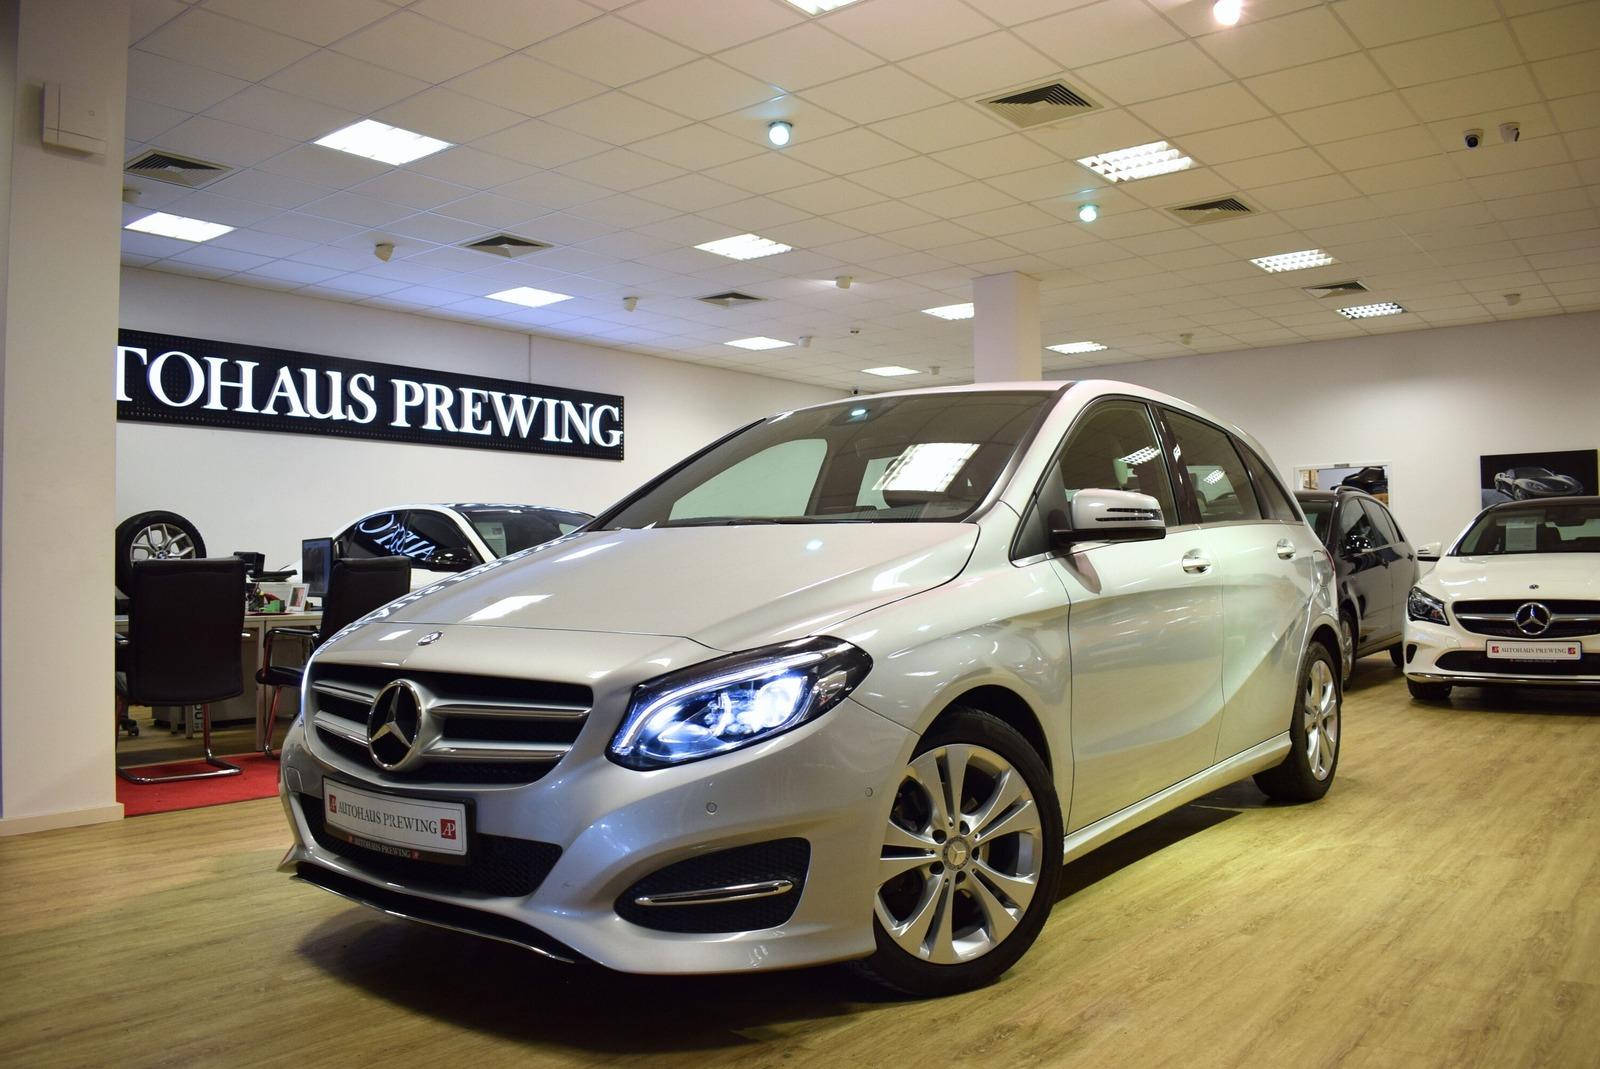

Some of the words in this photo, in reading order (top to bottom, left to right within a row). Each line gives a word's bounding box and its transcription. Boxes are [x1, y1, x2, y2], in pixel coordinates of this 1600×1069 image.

[388, 378, 623, 448] PREWING
[338, 801, 382, 825] AUTOHAUS
[383, 812, 438, 835] PREWING
